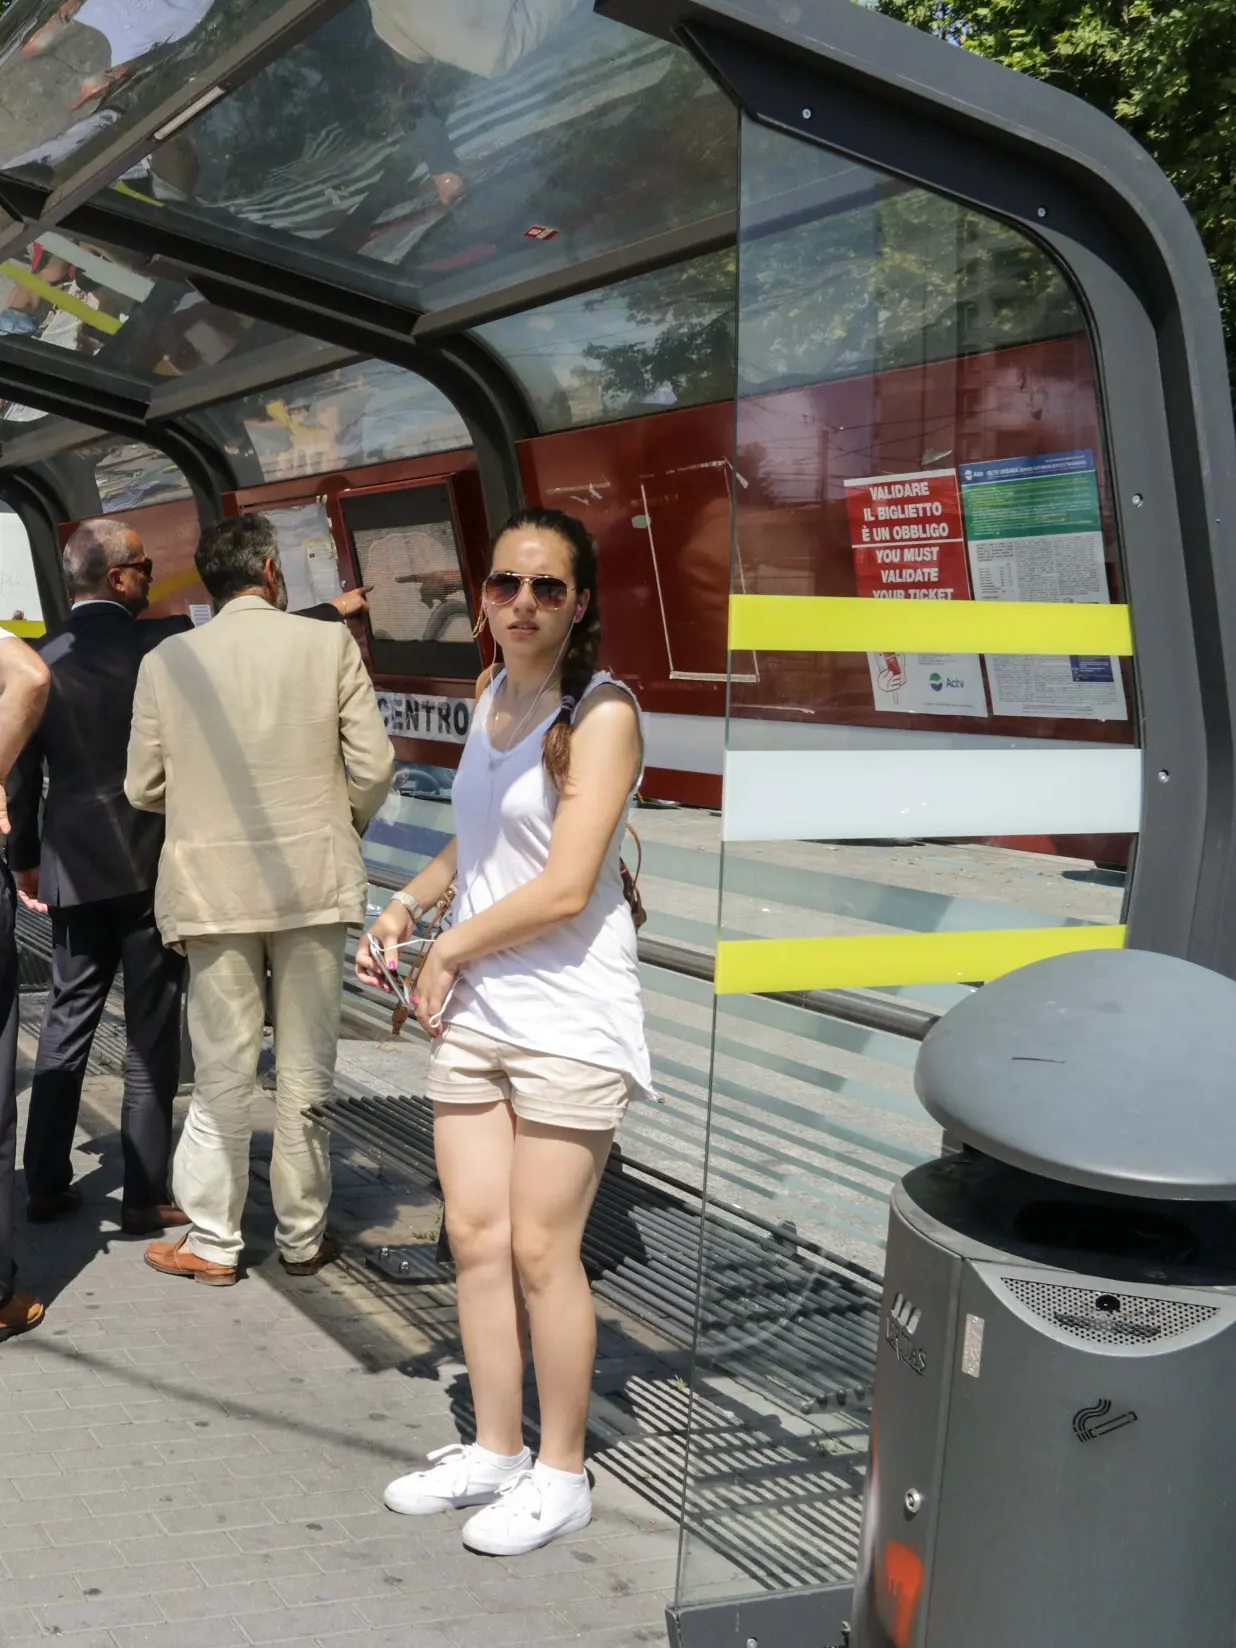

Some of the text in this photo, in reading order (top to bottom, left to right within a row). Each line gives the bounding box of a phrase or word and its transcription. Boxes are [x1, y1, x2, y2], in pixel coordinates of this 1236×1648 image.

[869, 481, 930, 501] VALIDARE
[863, 502, 942, 522] IL BIGLIETTO
[861, 522, 949, 542] È UN OBBLIGO
[876, 546, 940, 564] YOU MUST
[880, 567, 939, 583] VALIDATE
[945, 677, 965, 688] Actv
